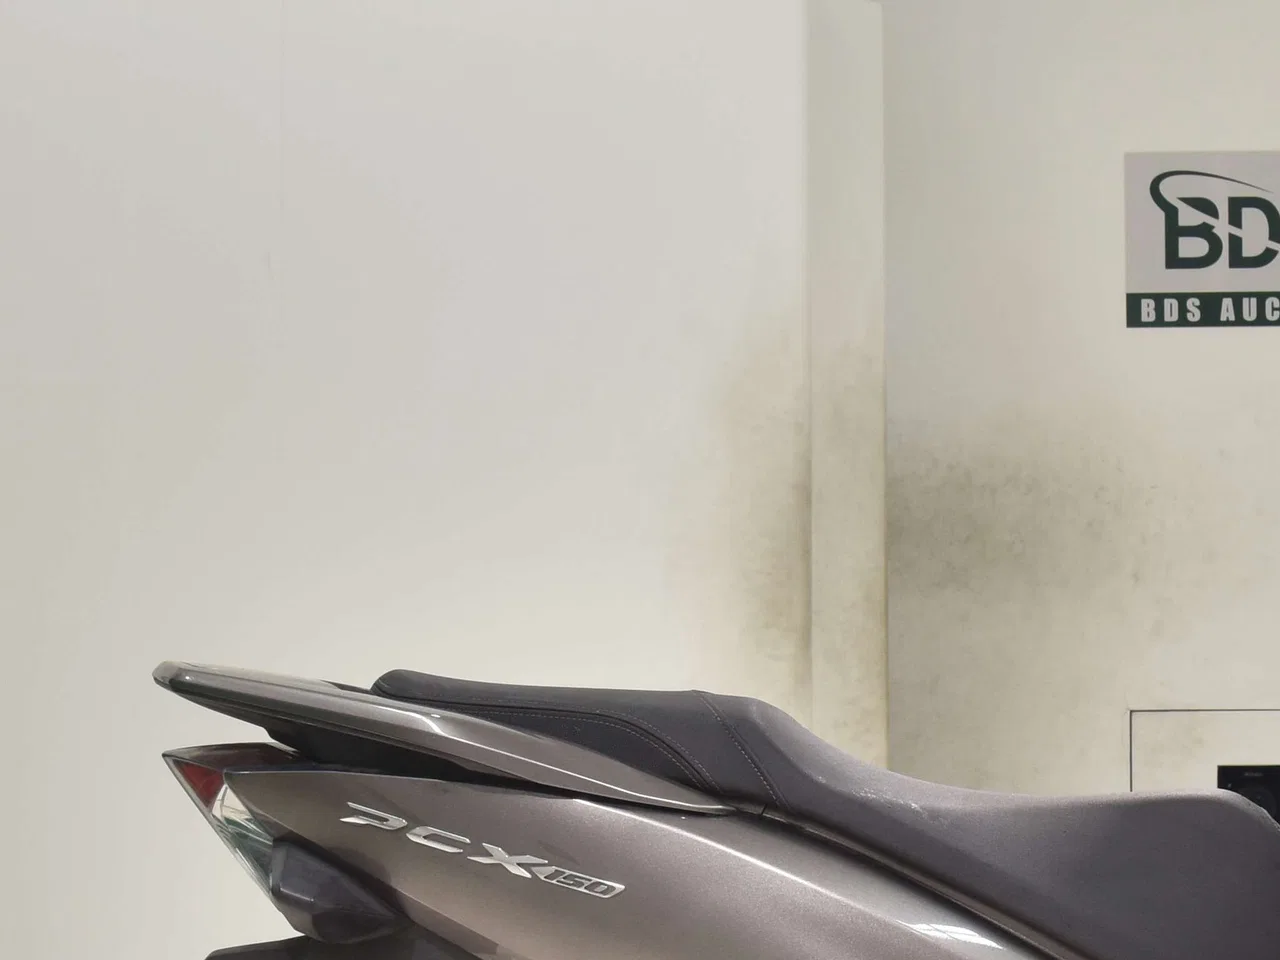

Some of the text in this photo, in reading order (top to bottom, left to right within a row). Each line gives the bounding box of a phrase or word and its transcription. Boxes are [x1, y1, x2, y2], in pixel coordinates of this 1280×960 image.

[1140, 297, 1202, 323] BDS
[339, 801, 618, 897] PCX 150
